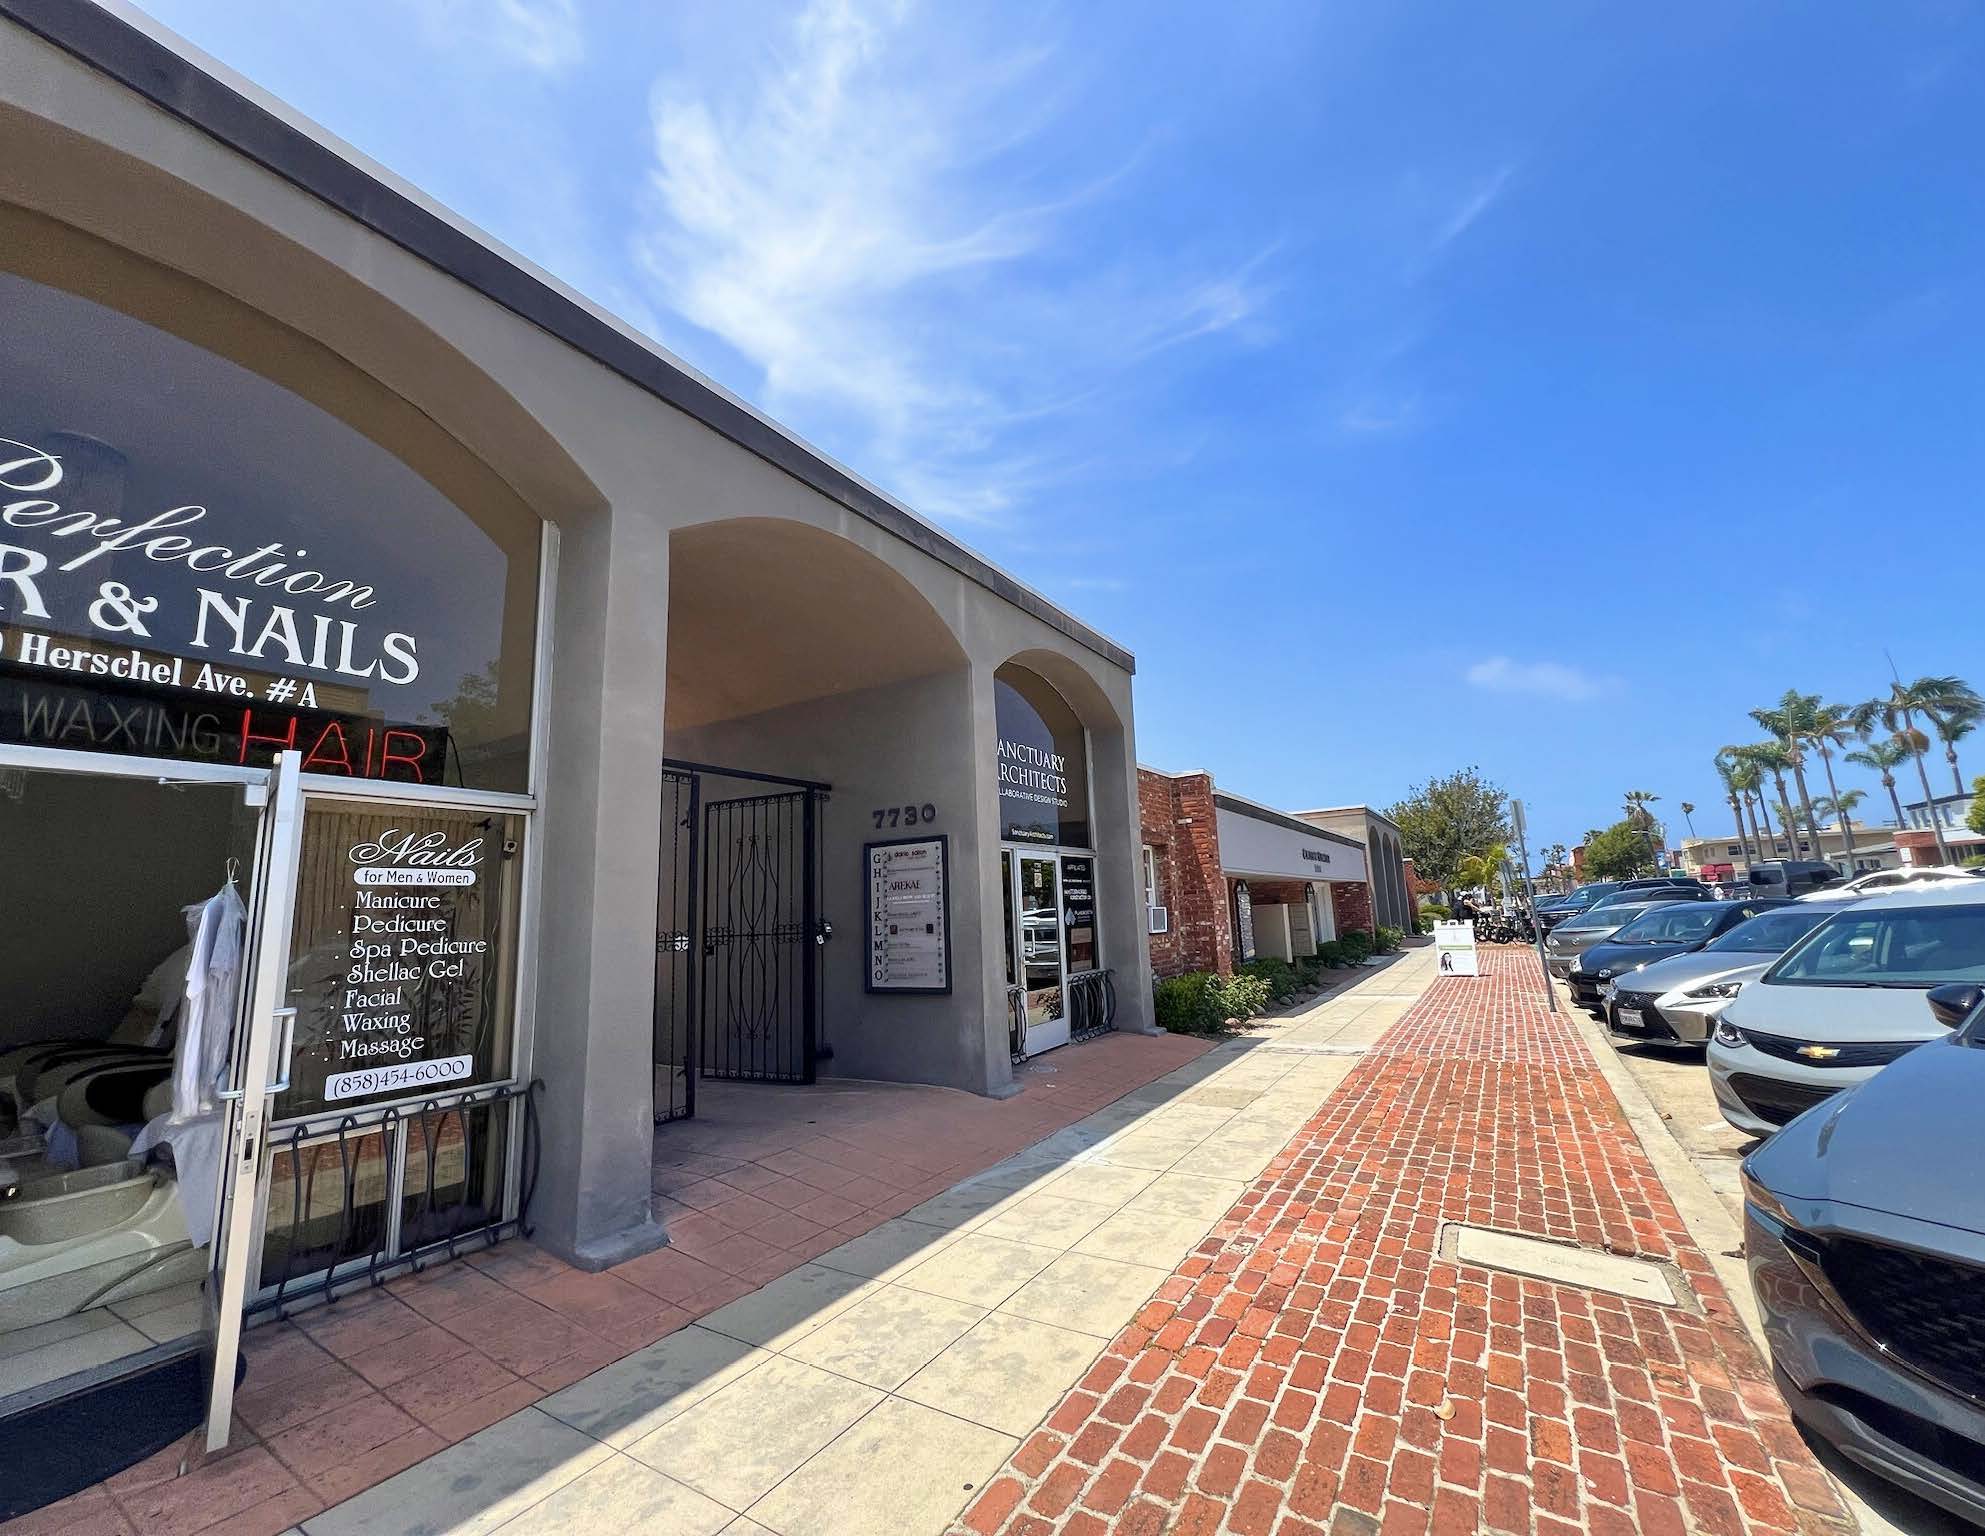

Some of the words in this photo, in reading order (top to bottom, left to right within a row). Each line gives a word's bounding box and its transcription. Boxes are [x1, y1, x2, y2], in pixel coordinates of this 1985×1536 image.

[88, 581, 159, 639] &
[189, 586, 421, 685] NAILS
[18, 632, 183, 687] Herschel
[192, 668, 255, 699] Ave.
[266, 677, 319, 709] #A
[21, 692, 221, 755] WAXING
[239, 708, 426, 783] HAIR
[997, 763, 1067, 794] RCHITECTS
[1034, 794, 1051, 805] DESIGN
[1051, 797, 1069, 808] STUDIO
[872, 803, 937, 830] 7730
[348, 828, 485, 867] Nails
[364, 870, 383, 884] for
[386, 871, 413, 884] Men
[416, 874, 424, 884] &
[428, 871, 470, 884] Women
[873, 868, 882, 879] H
[354, 890, 441, 910] Manicure
[352, 915, 447, 934] Pedicure
[874, 911, 883, 922] K
[874, 925, 882, 937] L
[349, 939, 392, 965] Spa
[400, 936, 487, 956] Pedicure
[873, 940, 883, 952] M
[346, 960, 421, 985] Shellac
[428, 958, 464, 980] Gel
[874, 955, 883, 967] N
[343, 987, 402, 1009] Facial
[343, 1012, 411, 1034] Waxing
[340, 1035, 425, 1059] Massage
[333, 1059, 465, 1099] (858)454-6000
